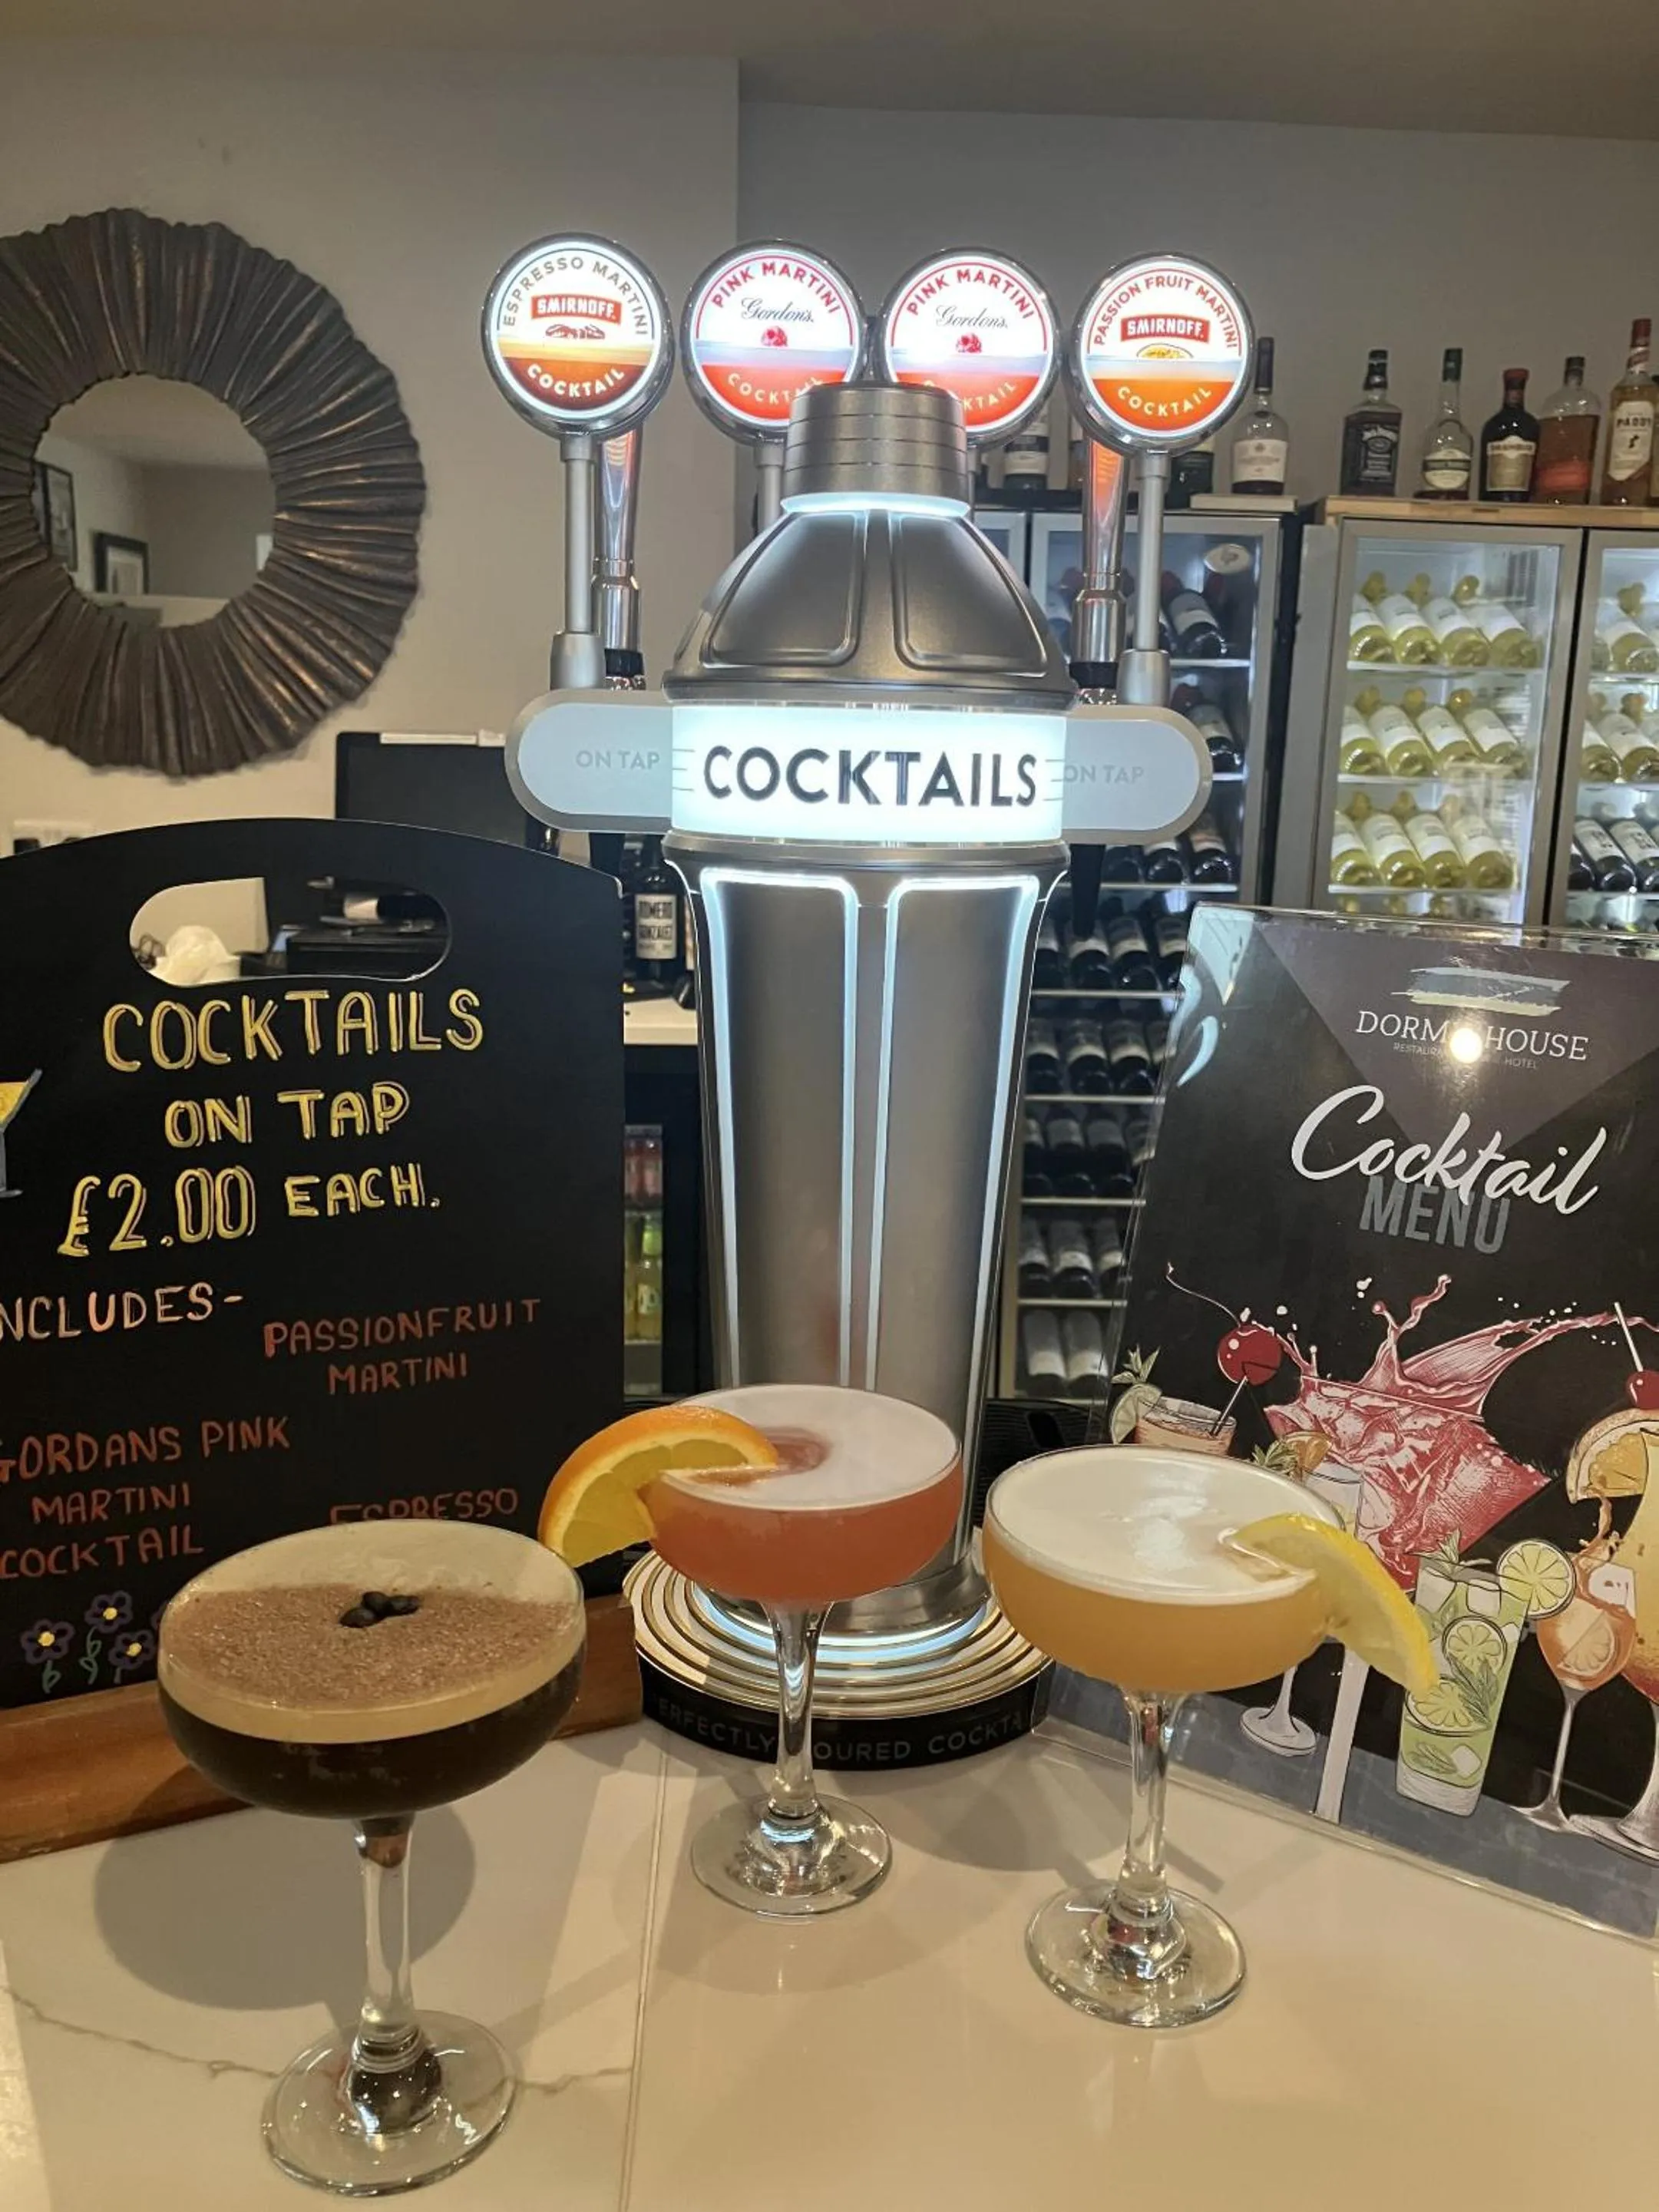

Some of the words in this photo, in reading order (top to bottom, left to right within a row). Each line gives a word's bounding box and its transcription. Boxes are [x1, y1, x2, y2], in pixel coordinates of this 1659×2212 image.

[503, 256, 584, 327] ESPRESSO
[592, 260, 649, 336] MARTINI
[711, 266, 755, 309] PINK
[761, 262, 841, 315] MARTINI
[907, 273, 950, 316] PINK
[956, 268, 1036, 321] MARTINI
[1094, 282, 1142, 346] PASSION
[1145, 275, 1195, 291] FRUIT
[1195, 284, 1239, 349] MARTINI
[527, 363, 626, 398] COCKTAIL
[1117, 384, 1215, 418] COCKTAIL
[575, 749, 613, 769] ON
[616, 749, 661, 771] TAP
[703, 744, 1038, 808] COCKTAILS
[1063, 764, 1096, 783] ON
[1102, 764, 1145, 784] TAP
[102, 988, 484, 1073] COCKTAILS
[1356, 1010, 1451, 1043] DORM
[1485, 1024, 1590, 1062] HOUSE
[164, 1093, 253, 1149] ON
[276, 1080, 410, 1140] TAP
[1291, 1085, 1608, 1215] Cocktail
[56, 1165, 257, 1258] £2.00
[283, 1162, 441, 1218] EACH.
[1358, 1175, 1511, 1255] MENU
[0, 1281, 245, 1342] NCLUDES-
[263, 1298, 542, 1358] PASSIONFRUIT
[327, 1351, 469, 1395] MARTINI
[201, 1417, 291, 1461] PINK
[31, 1483, 191, 1526] MARTINI
[0, 1525, 205, 1581] COCKTAIL
[812, 1741, 912, 1762] OURED
[927, 1710, 1024, 1756] COCKTA
